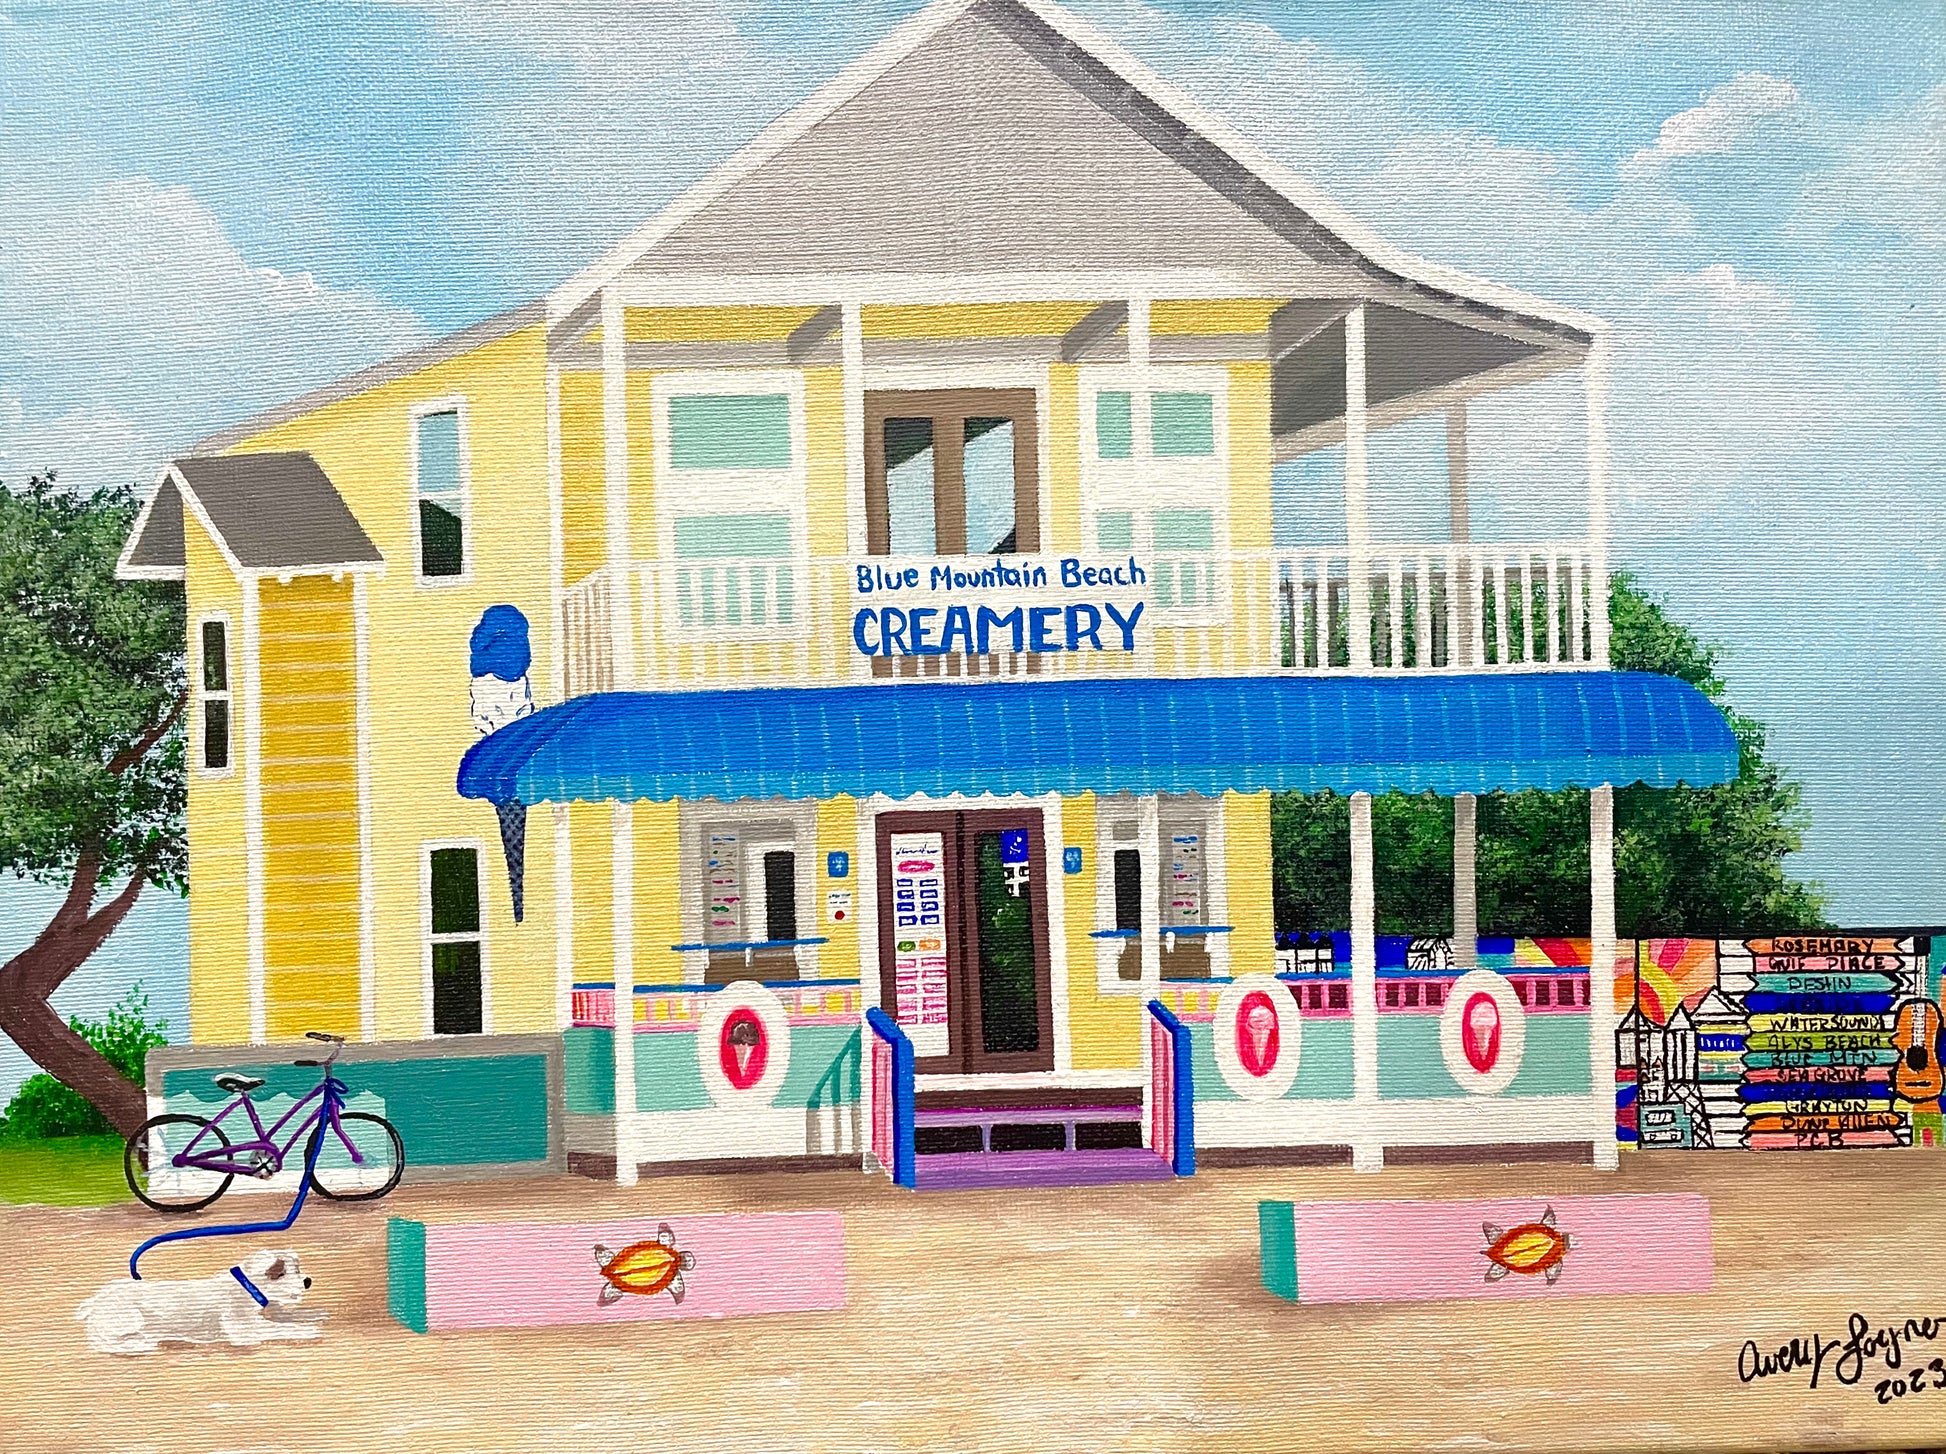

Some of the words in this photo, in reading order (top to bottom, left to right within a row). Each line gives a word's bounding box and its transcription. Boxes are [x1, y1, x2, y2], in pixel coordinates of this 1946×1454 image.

[857, 564, 919, 593] Blue
[930, 559, 1047, 591] Mountain
[1060, 556, 1146, 588] Beach
[853, 601, 1144, 657] CREAMERY
[1772, 939, 1874, 953] ROSEMARY
[1768, 1034, 1813, 1050] ALYS
[1823, 1033, 1881, 1050] BEACH
[1874, 1358, 1946, 1405] 2023
